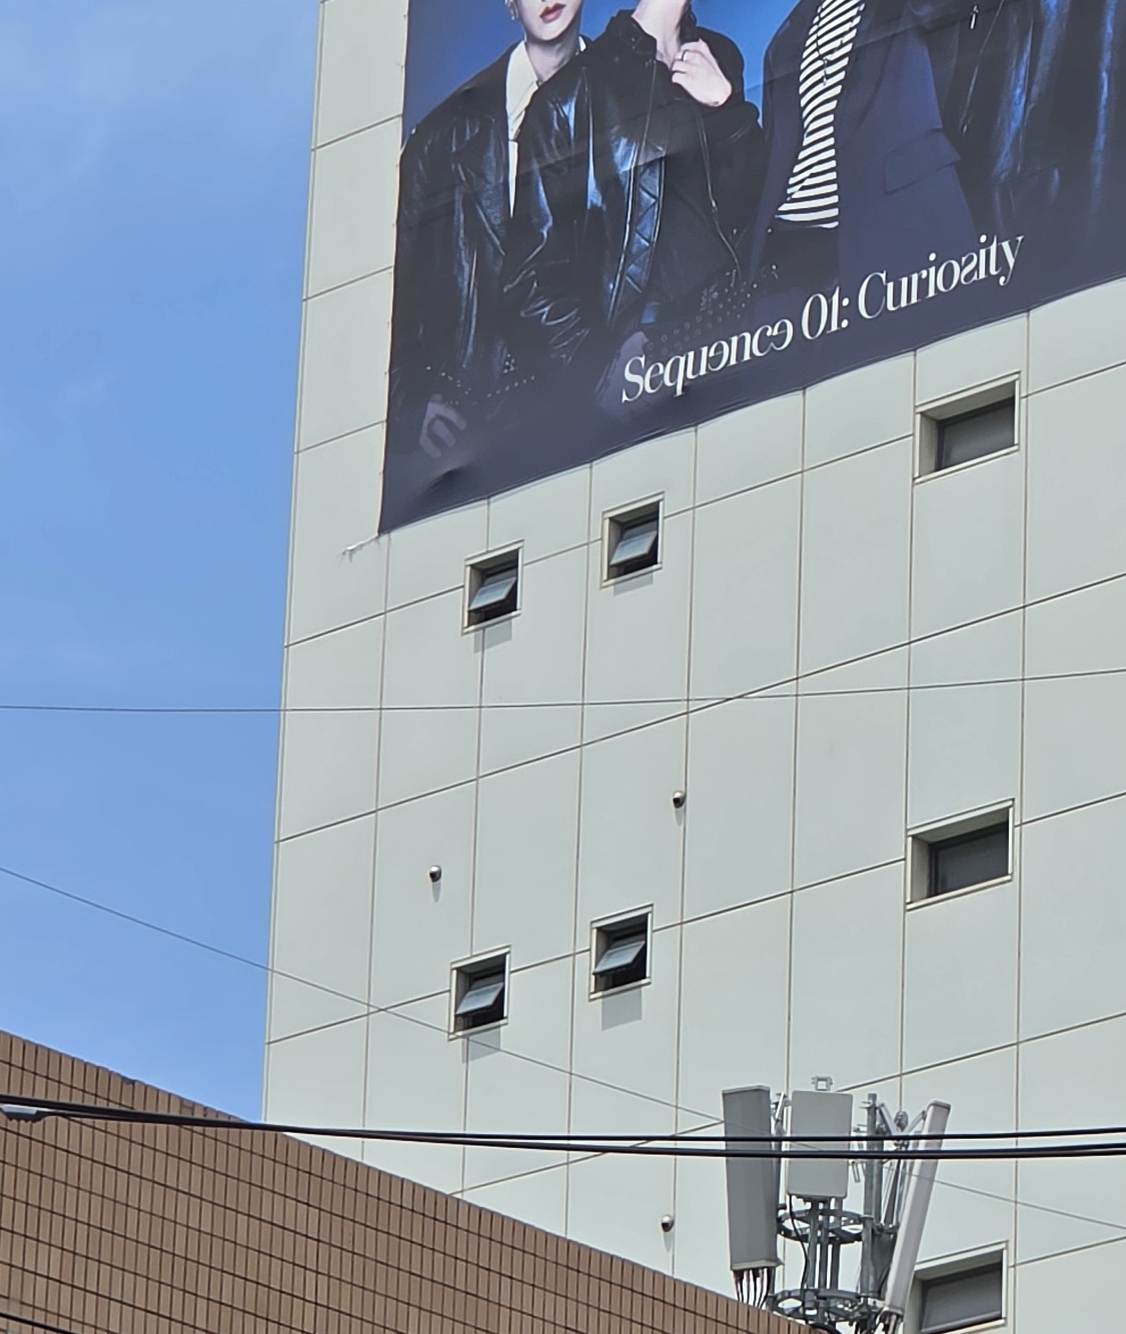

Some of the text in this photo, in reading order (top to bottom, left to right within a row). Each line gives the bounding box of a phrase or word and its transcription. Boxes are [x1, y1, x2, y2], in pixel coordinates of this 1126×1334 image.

[621, 233, 1025, 403] Sequence 01: Curiosity
